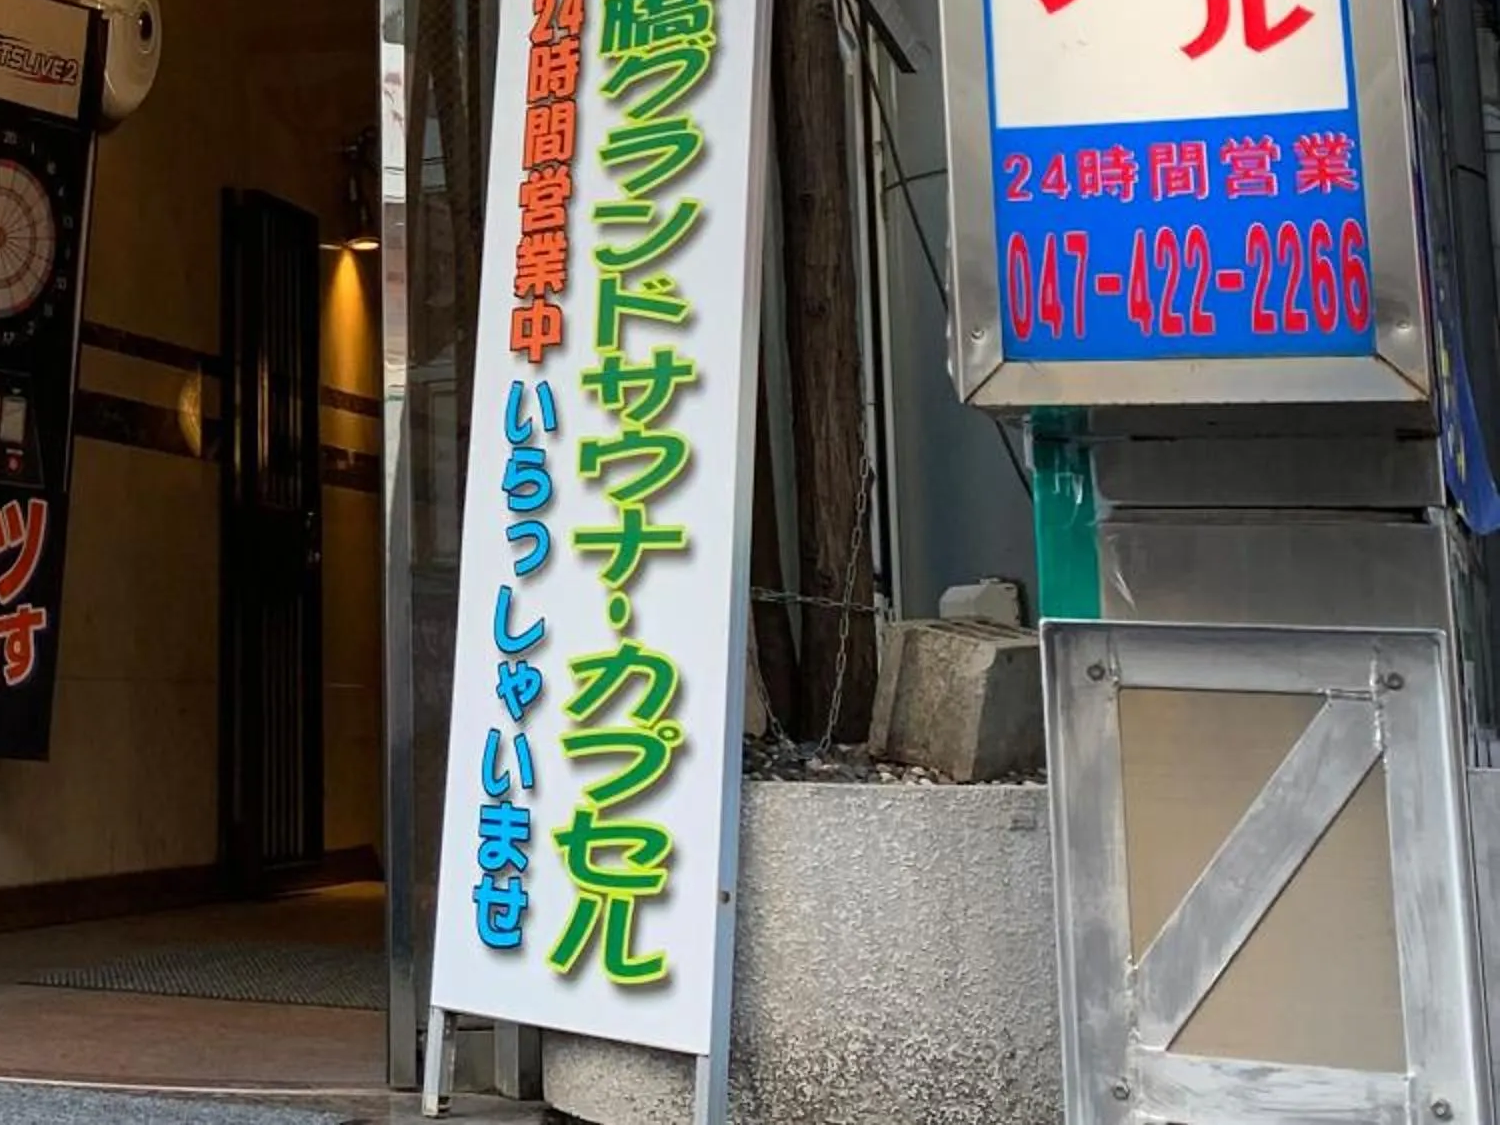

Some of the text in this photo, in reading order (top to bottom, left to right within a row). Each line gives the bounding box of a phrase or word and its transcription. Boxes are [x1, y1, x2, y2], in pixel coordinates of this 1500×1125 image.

[1002, 132, 1360, 203] 24時間営業
[1006, 218, 1372, 341] 047-422-2266
[472, 380, 557, 950] いらっしゃいませ
